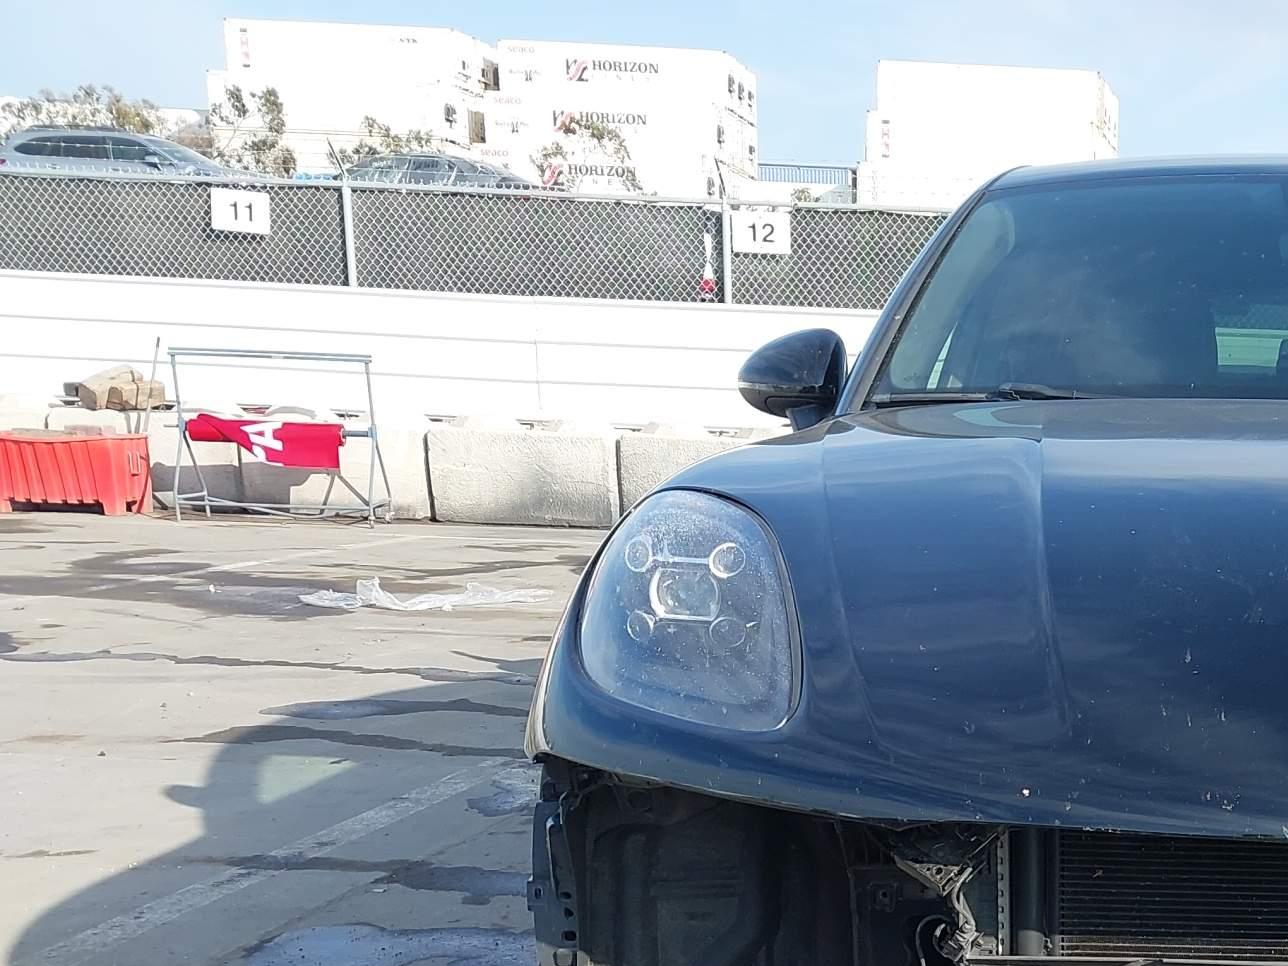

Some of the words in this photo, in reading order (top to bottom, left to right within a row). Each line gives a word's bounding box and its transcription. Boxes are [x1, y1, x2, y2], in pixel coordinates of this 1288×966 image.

[592, 60, 660, 74] HORIZON
[579, 111, 647, 125] HORIZON
[567, 164, 636, 178] HORIZON
[229, 201, 253, 222] 11
[747, 223, 775, 243] 12
